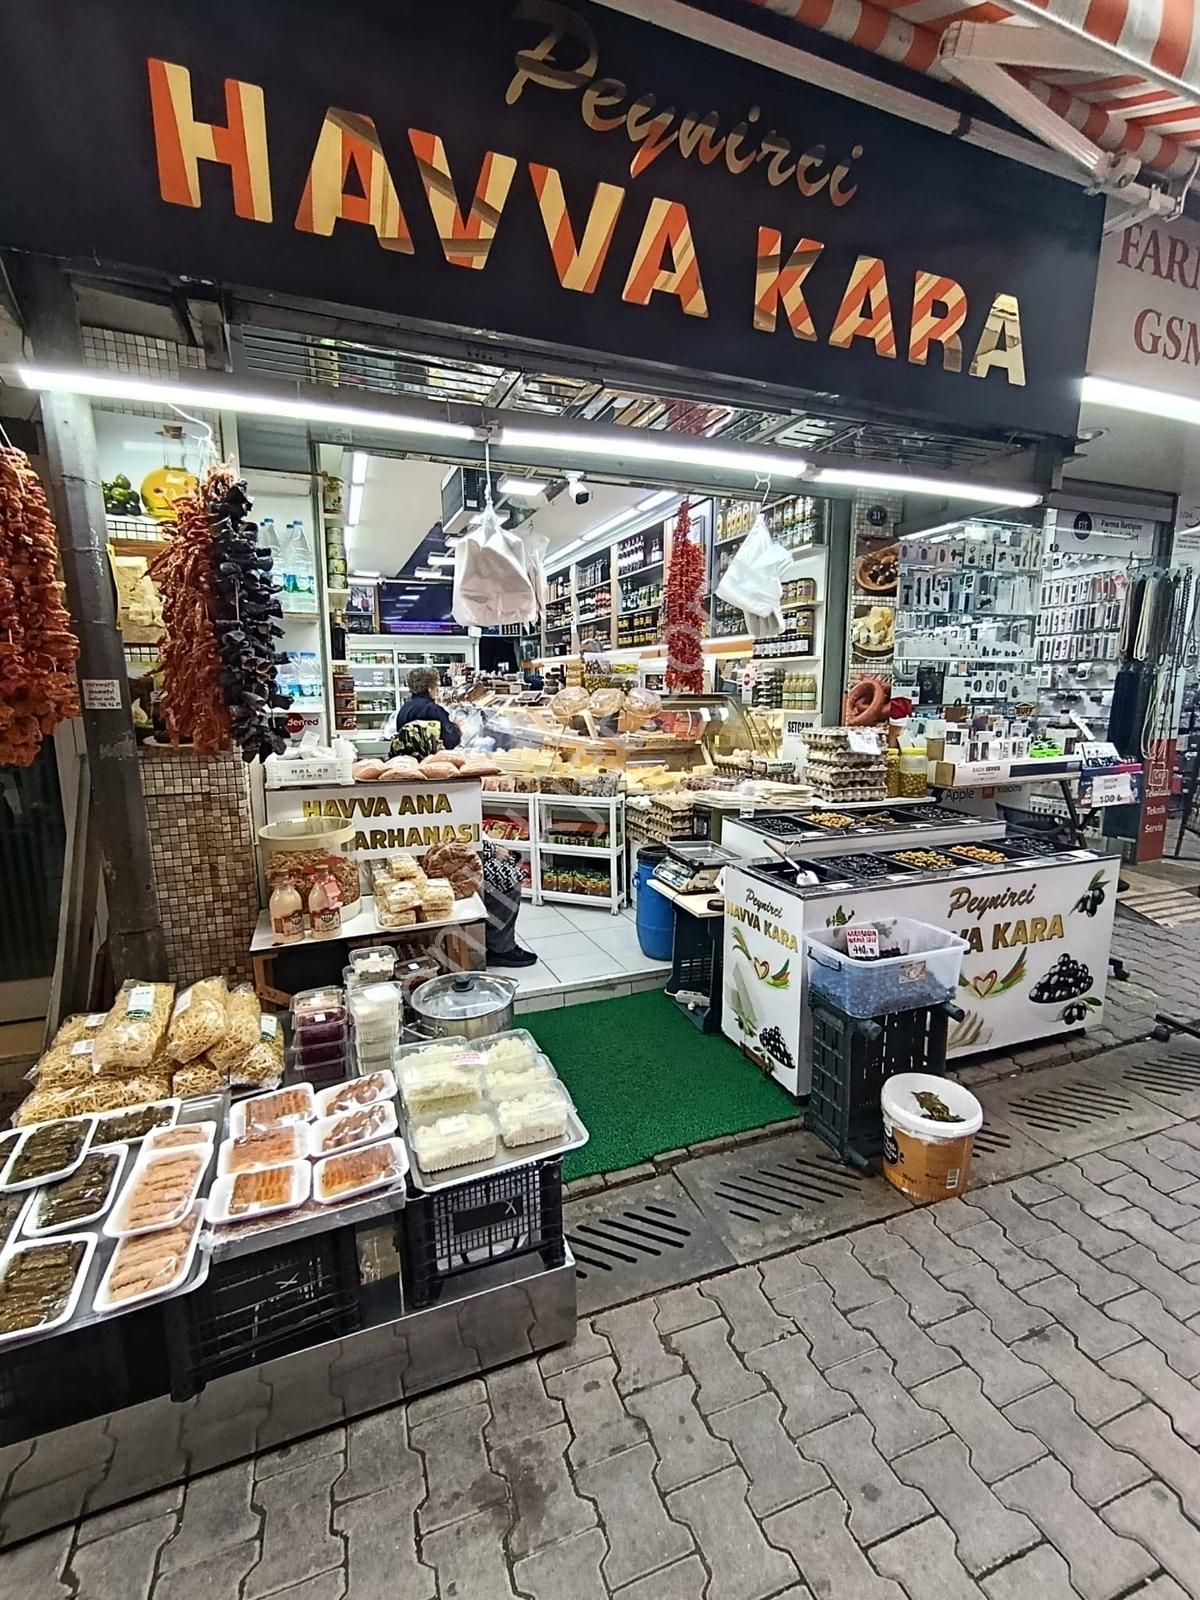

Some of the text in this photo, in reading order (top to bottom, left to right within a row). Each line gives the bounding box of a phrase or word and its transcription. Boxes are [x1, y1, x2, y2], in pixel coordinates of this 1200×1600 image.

[506, 1, 864, 208] Peynirci
[147, 57, 1027, 387] HAVVA KARA
[1117, 223, 1200, 290] FAR
[287, 718, 319, 726] denred
[302, 793, 452, 818] HAVVA ANA
[945, 788, 975, 803] Apple
[345, 823, 481, 851] ARHANASI
[1145, 823, 1164, 833] Servis
[746, 888, 783, 919] Peynirci
[947, 883, 1037, 920] Peynirci
[726, 899, 798, 953] HAVVA KARA
[991, 914, 1065, 950] KARA
